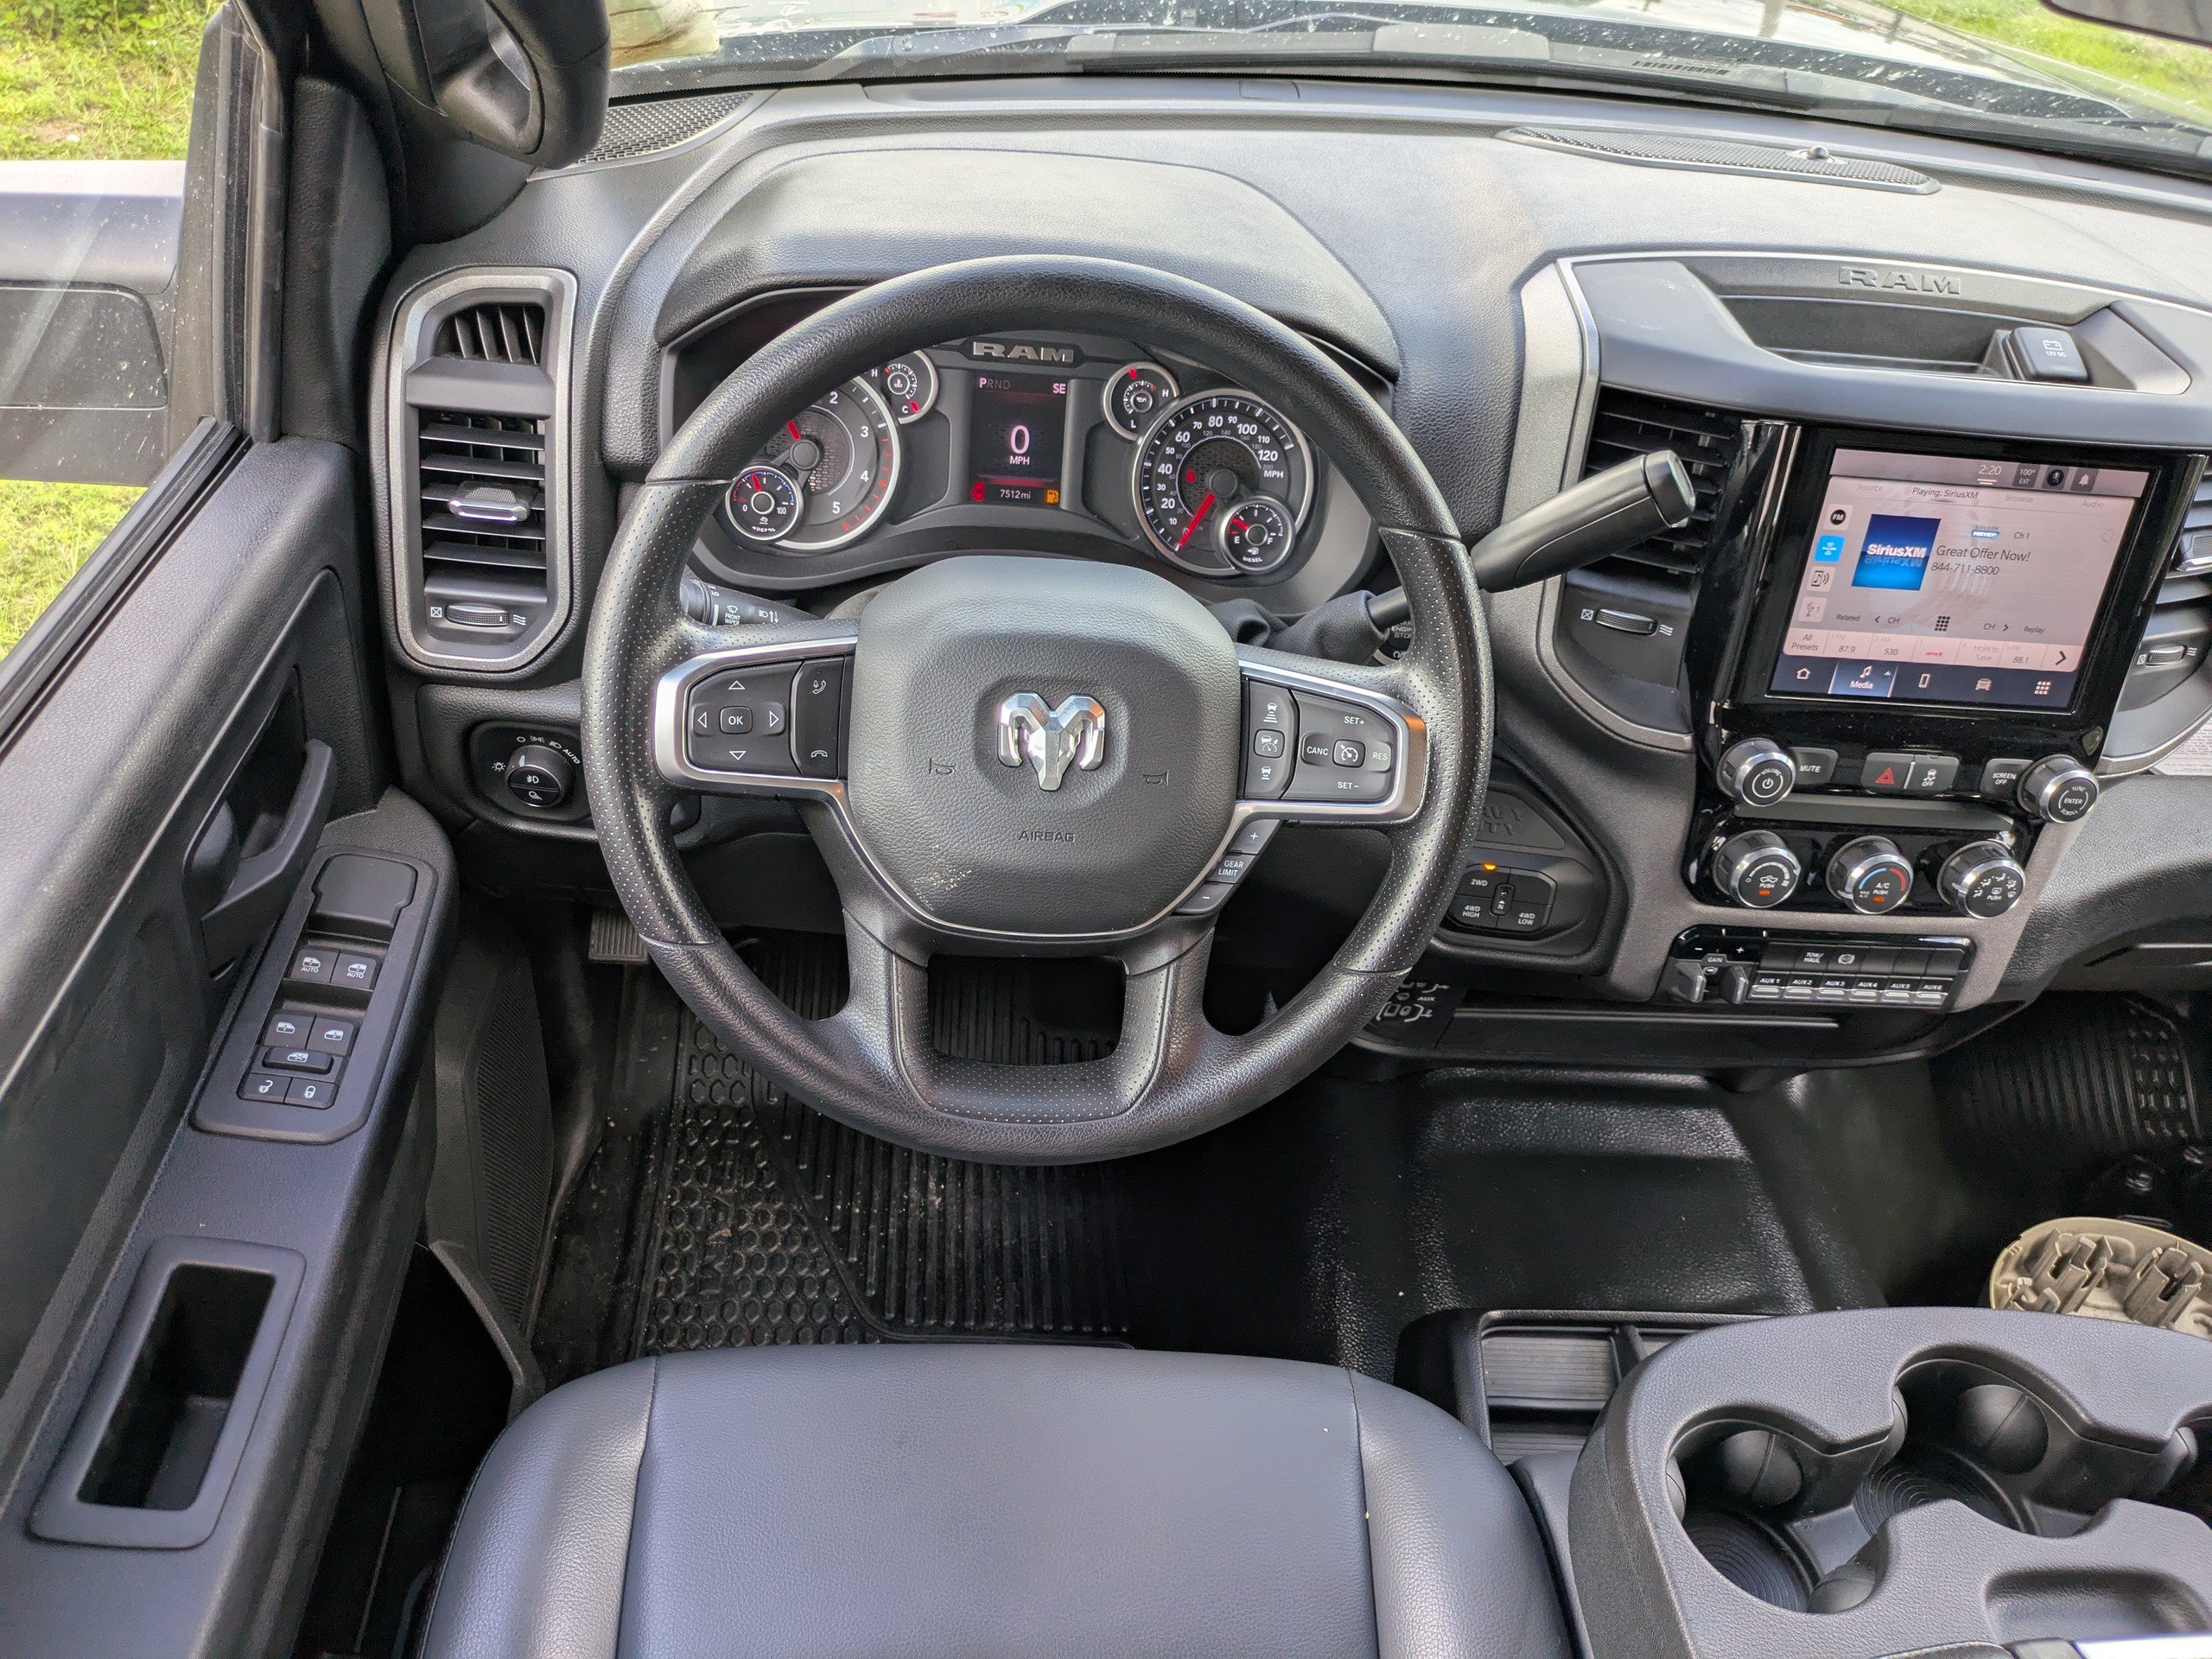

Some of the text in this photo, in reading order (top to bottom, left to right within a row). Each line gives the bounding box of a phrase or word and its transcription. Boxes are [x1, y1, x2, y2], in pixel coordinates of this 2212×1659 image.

[1839, 266, 1961, 295] RAM
[973, 341, 1075, 363] RAM
[871, 369, 878, 378] H
[979, 378, 1011, 390] PRND
[1052, 383, 1066, 394] SE
[830, 391, 838, 404] 2
[902, 405, 909, 414] C
[1130, 420, 1136, 429] L
[1208, 416, 1224, 428] 80
[860, 426, 869, 438] 3
[1236, 423, 1258, 435] 100
[1010, 425, 1030, 454] 0
[1175, 431, 1191, 443] 60
[1257, 435, 1270, 444] 110
[1009, 456, 1031, 466] MPH
[1257, 449, 1279, 462] 120
[1158, 463, 1173, 475] 40
[1263, 470, 1284, 479] MPH
[1978, 464, 2002, 475] 2:20
[860, 470, 869, 482] 4
[1856, 484, 1884, 493] Source
[1911, 487, 1979, 499] Playing: SiriusXM
[1160, 498, 1175, 509] 20
[2005, 494, 2034, 503] Browse
[2082, 499, 2104, 508] Audio
[832, 501, 841, 514] 5
[1866, 543, 1927, 558] SiriusXM
[1936, 545, 2031, 562] Great Offer Now!
[1930, 562, 2000, 575] 844-711-8800
[1835, 613, 1861, 622] Related
[1983, 622, 1996, 631] CH
[2024, 626, 2045, 634] Replay
[1790, 643, 1819, 652] Presets
[1974, 644, 1992, 652] Hold
[1975, 653, 1993, 662] Save
[1849, 681, 1873, 690] Media
[728, 715, 743, 726] OK
[1344, 715, 1365, 726] SET+
[563, 748, 581, 764] AUTO
[1306, 747, 1329, 756] CANC
[1372, 752, 1388, 761] RES
[1019, 830, 1076, 842] AIRBAG
[1224, 859, 1244, 869] GEAR
[1218, 868, 1238, 876] LIMIT
